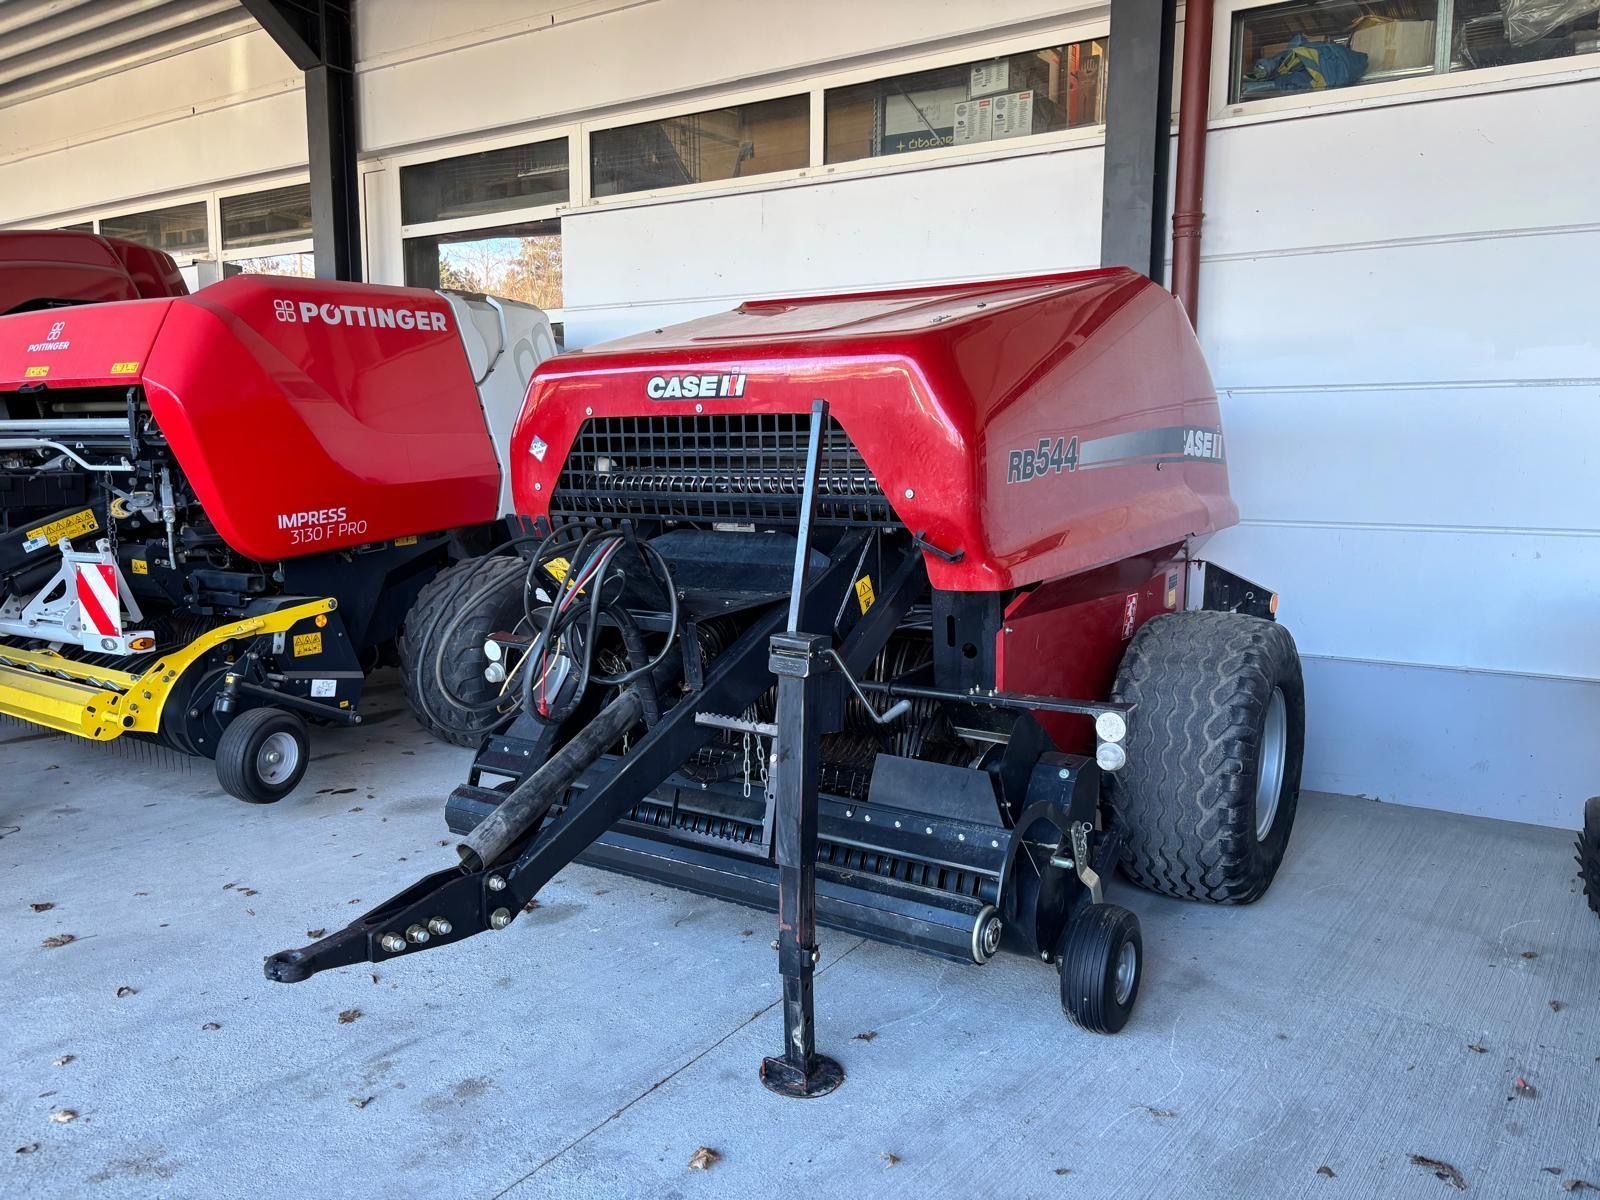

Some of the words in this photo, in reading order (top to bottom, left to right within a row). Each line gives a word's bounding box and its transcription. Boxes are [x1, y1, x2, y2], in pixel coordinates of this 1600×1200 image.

[647, 375, 719, 399] CASE
[1007, 436, 1079, 484] RB544
[277, 507, 347, 529] IMPRESS
[291, 526, 323, 545] 3130
[326, 525, 335, 539] F
[338, 520, 368, 537] PRO
